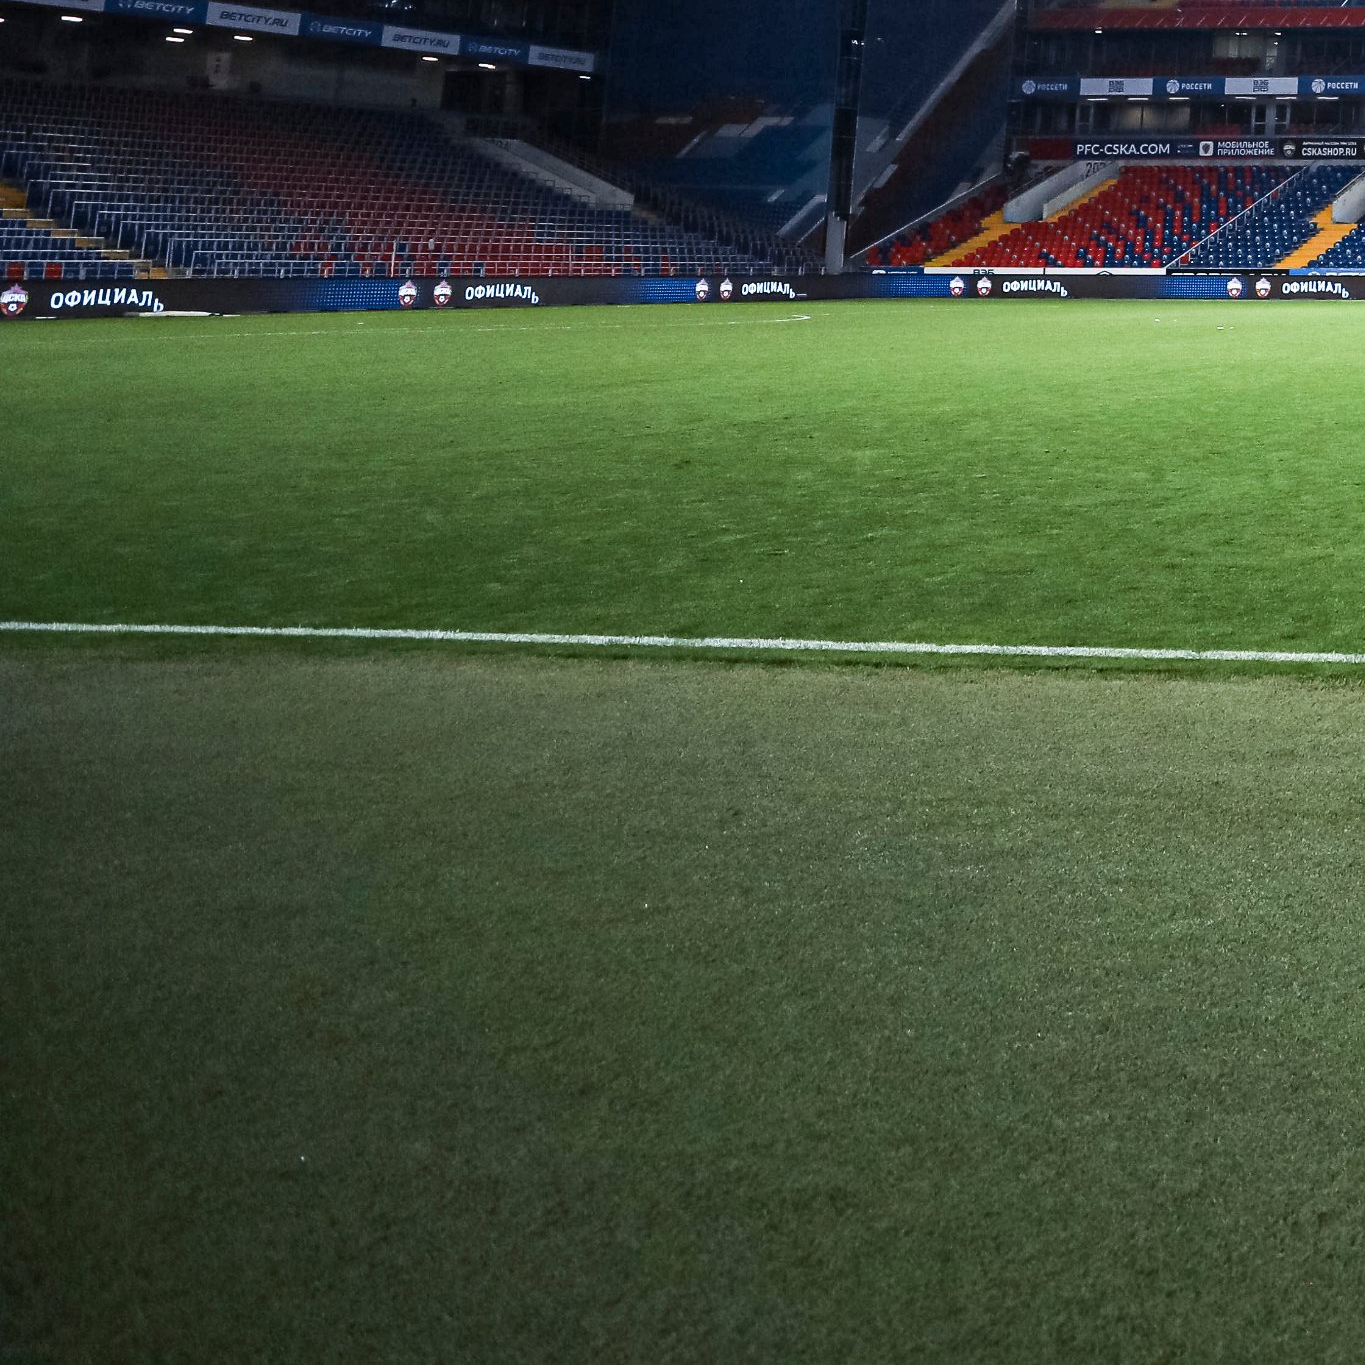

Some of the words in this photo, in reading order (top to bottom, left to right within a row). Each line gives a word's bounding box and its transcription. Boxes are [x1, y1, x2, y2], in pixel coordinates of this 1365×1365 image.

[134, 0, 194, 14] BETCITY
[220, 10, 289, 27] BETCITY.RU
[1037, 83, 1068, 91] РОССЕТИ
[1181, 82, 1212, 90] РОССЕТИ
[1327, 81, 1359, 89] РОССЕТИ
[1077, 144, 1169, 154] PFC-CSKA.COM
[1218, 148, 1275, 156] ПРИЛОЖЕНИЕ
[1302, 148, 1357, 156] CSKASHOP.RU
[466, 284, 540, 304] ОФИЦИАЛЬ
[742, 282, 796, 298] ОФИЦИАЛЬ
[1002, 280, 1068, 296] ОФИЦИАЛЬ
[1282, 282, 1348, 298] ОФИЦИАЛЬ
[50, 287, 164, 312] ОФИЦИАЛЬ
